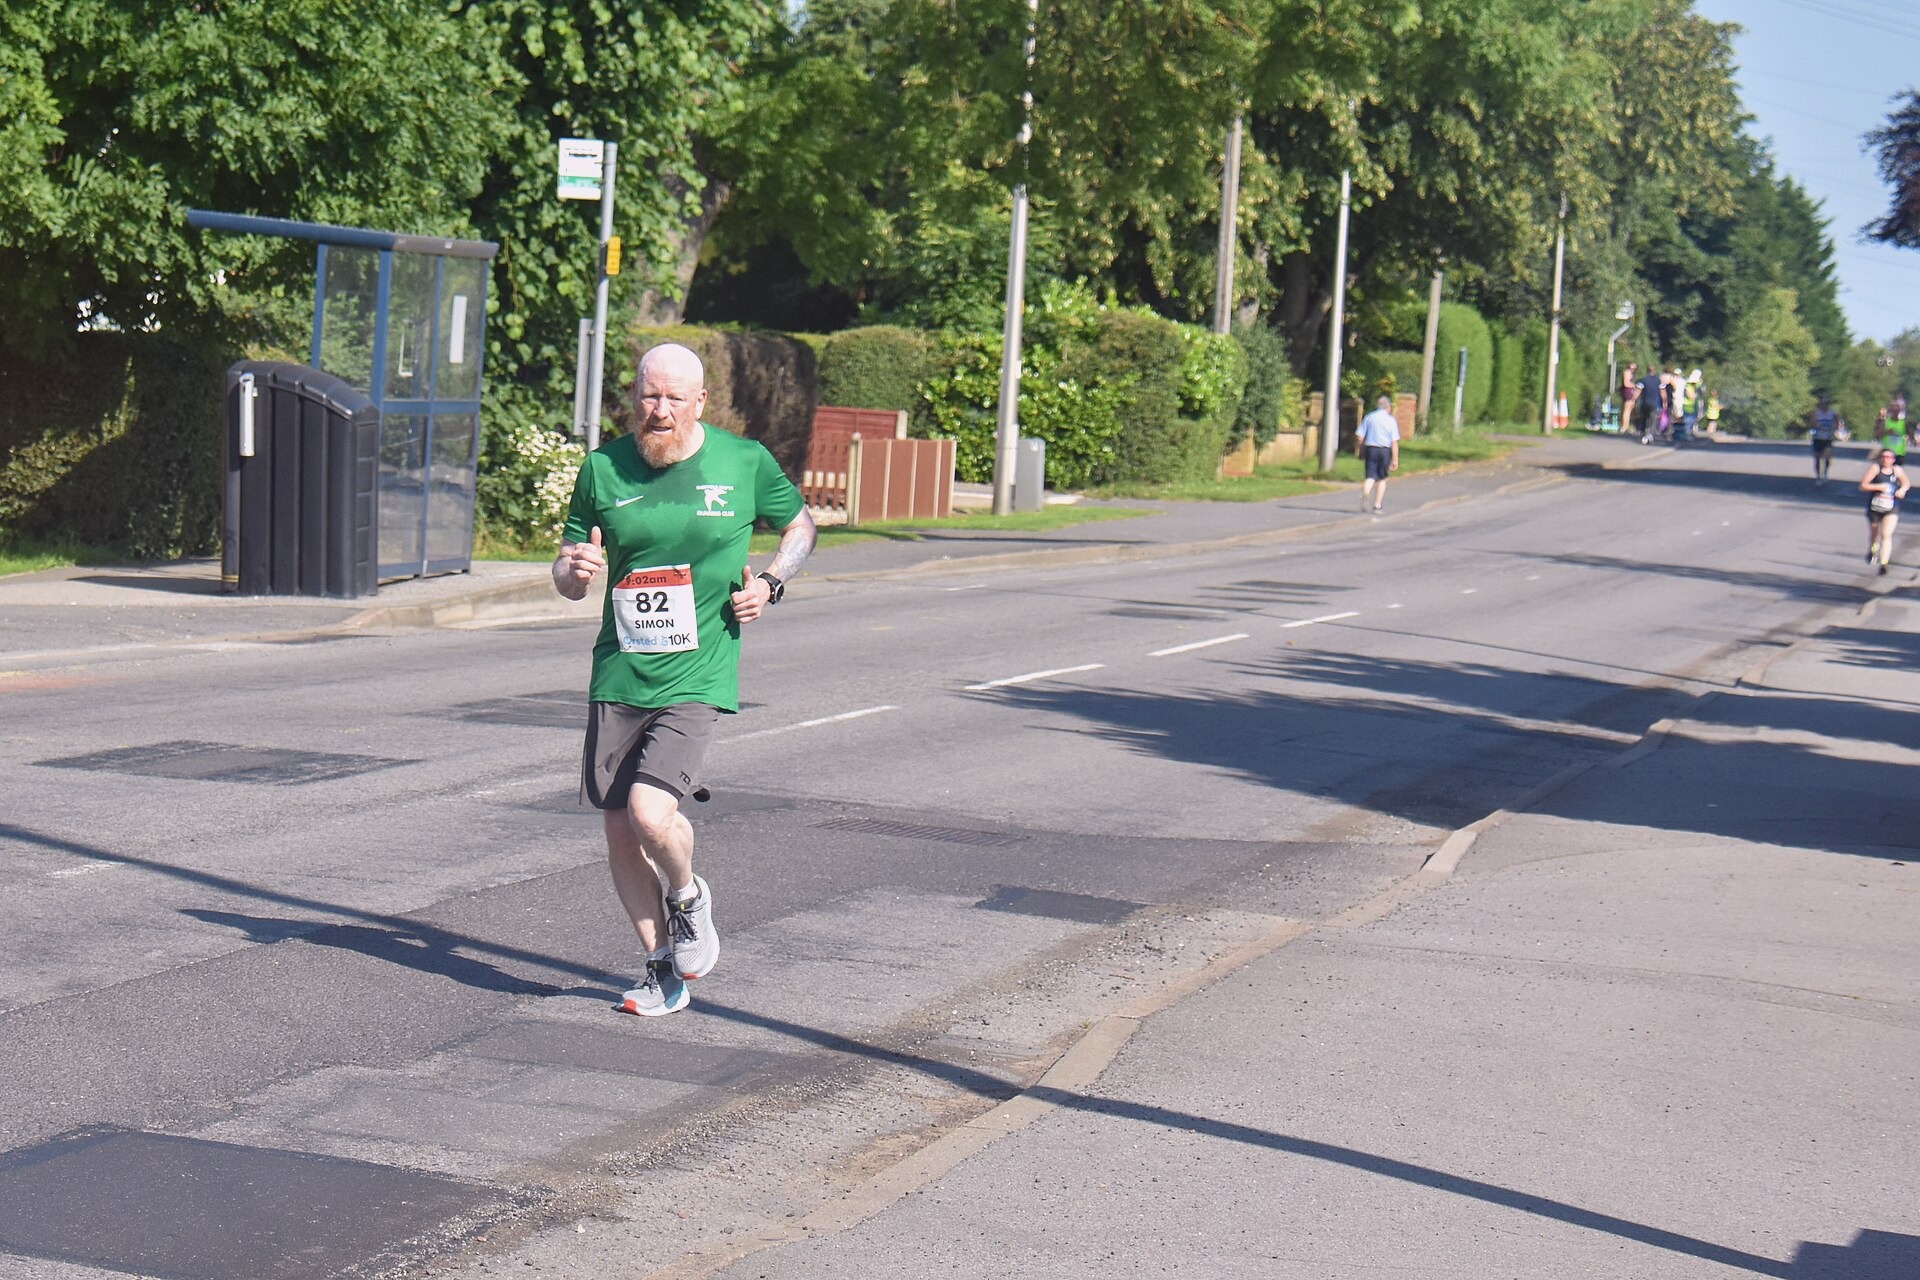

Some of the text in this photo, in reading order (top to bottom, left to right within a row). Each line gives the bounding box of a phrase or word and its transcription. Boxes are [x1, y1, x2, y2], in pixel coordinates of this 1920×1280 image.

[636, 592, 669, 613] 82
[635, 619, 674, 629] SIMON
[668, 632, 691, 645] 10K
